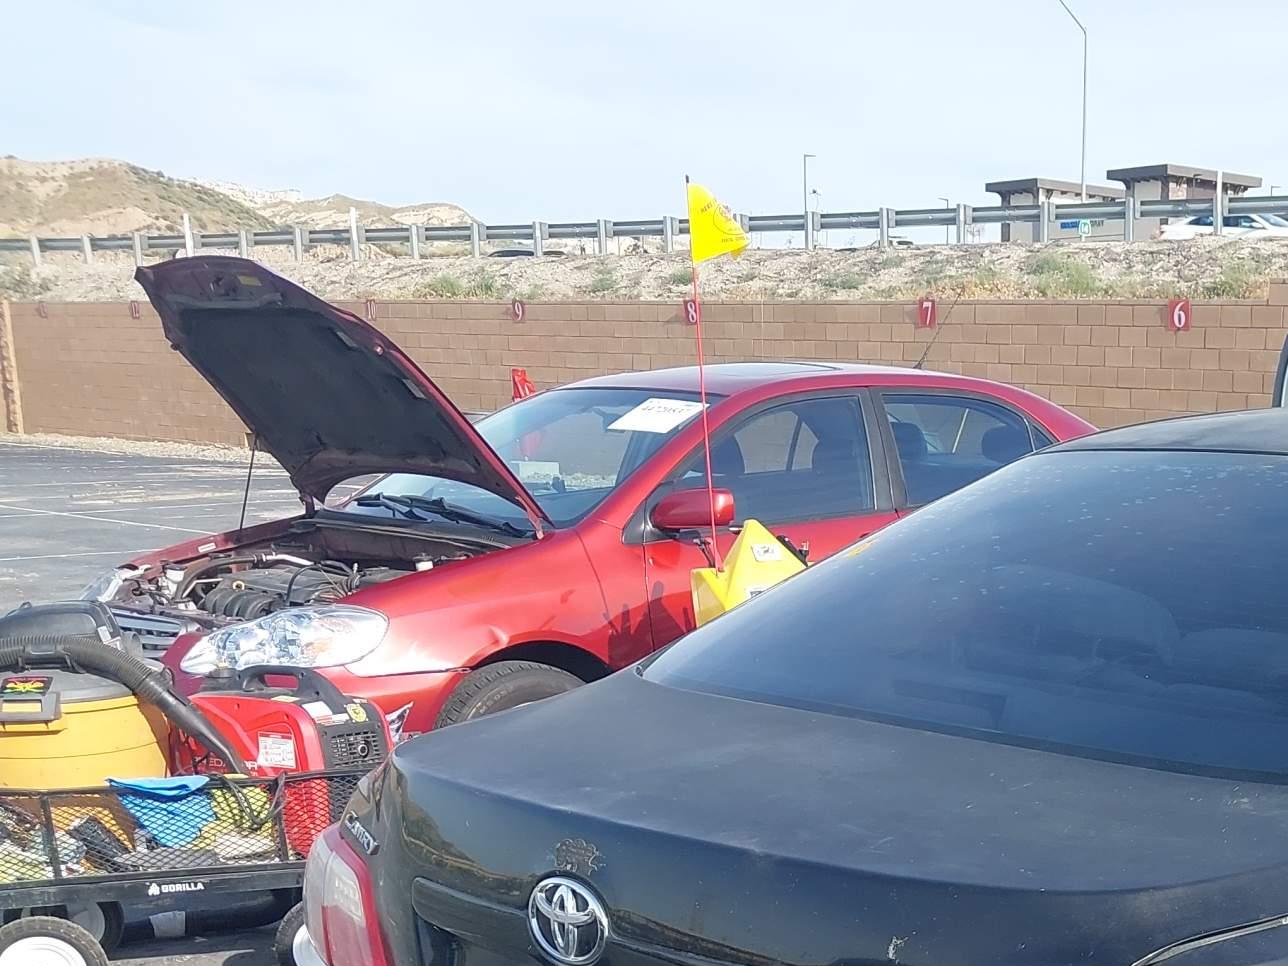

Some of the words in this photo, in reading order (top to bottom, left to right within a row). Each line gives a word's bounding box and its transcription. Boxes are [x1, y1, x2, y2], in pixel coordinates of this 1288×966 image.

[367, 300, 377, 320] 10
[514, 301, 523, 321] 9
[687, 301, 697, 323] 8
[922, 301, 932, 326] 7
[1173, 300, 1186, 328] 6
[161, 882, 206, 893] GORILLA
